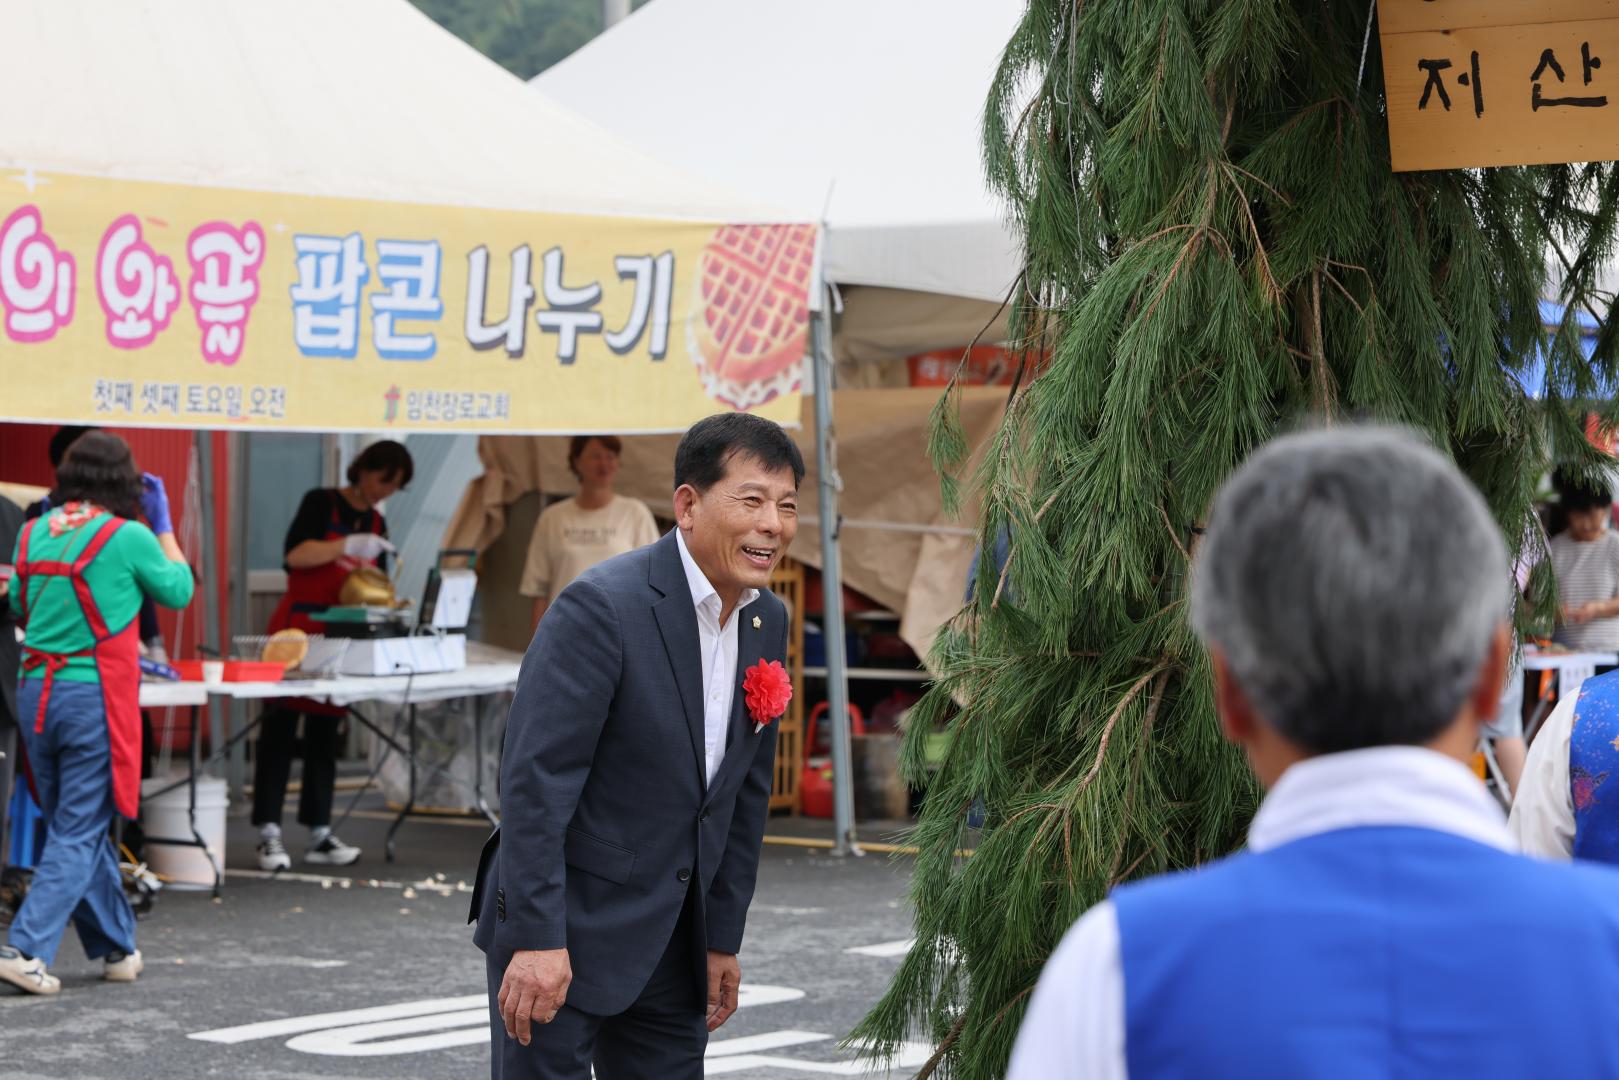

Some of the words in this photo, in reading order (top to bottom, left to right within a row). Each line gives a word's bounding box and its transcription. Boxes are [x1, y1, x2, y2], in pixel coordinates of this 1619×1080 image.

[289, 231, 444, 360] 팝콘
[465, 243, 674, 364] 나누기
[94, 379, 133, 414] 첫째
[140, 382, 179, 415] 셋째
[186, 384, 243, 418] 토요일
[249, 386, 287, 418] 오전
